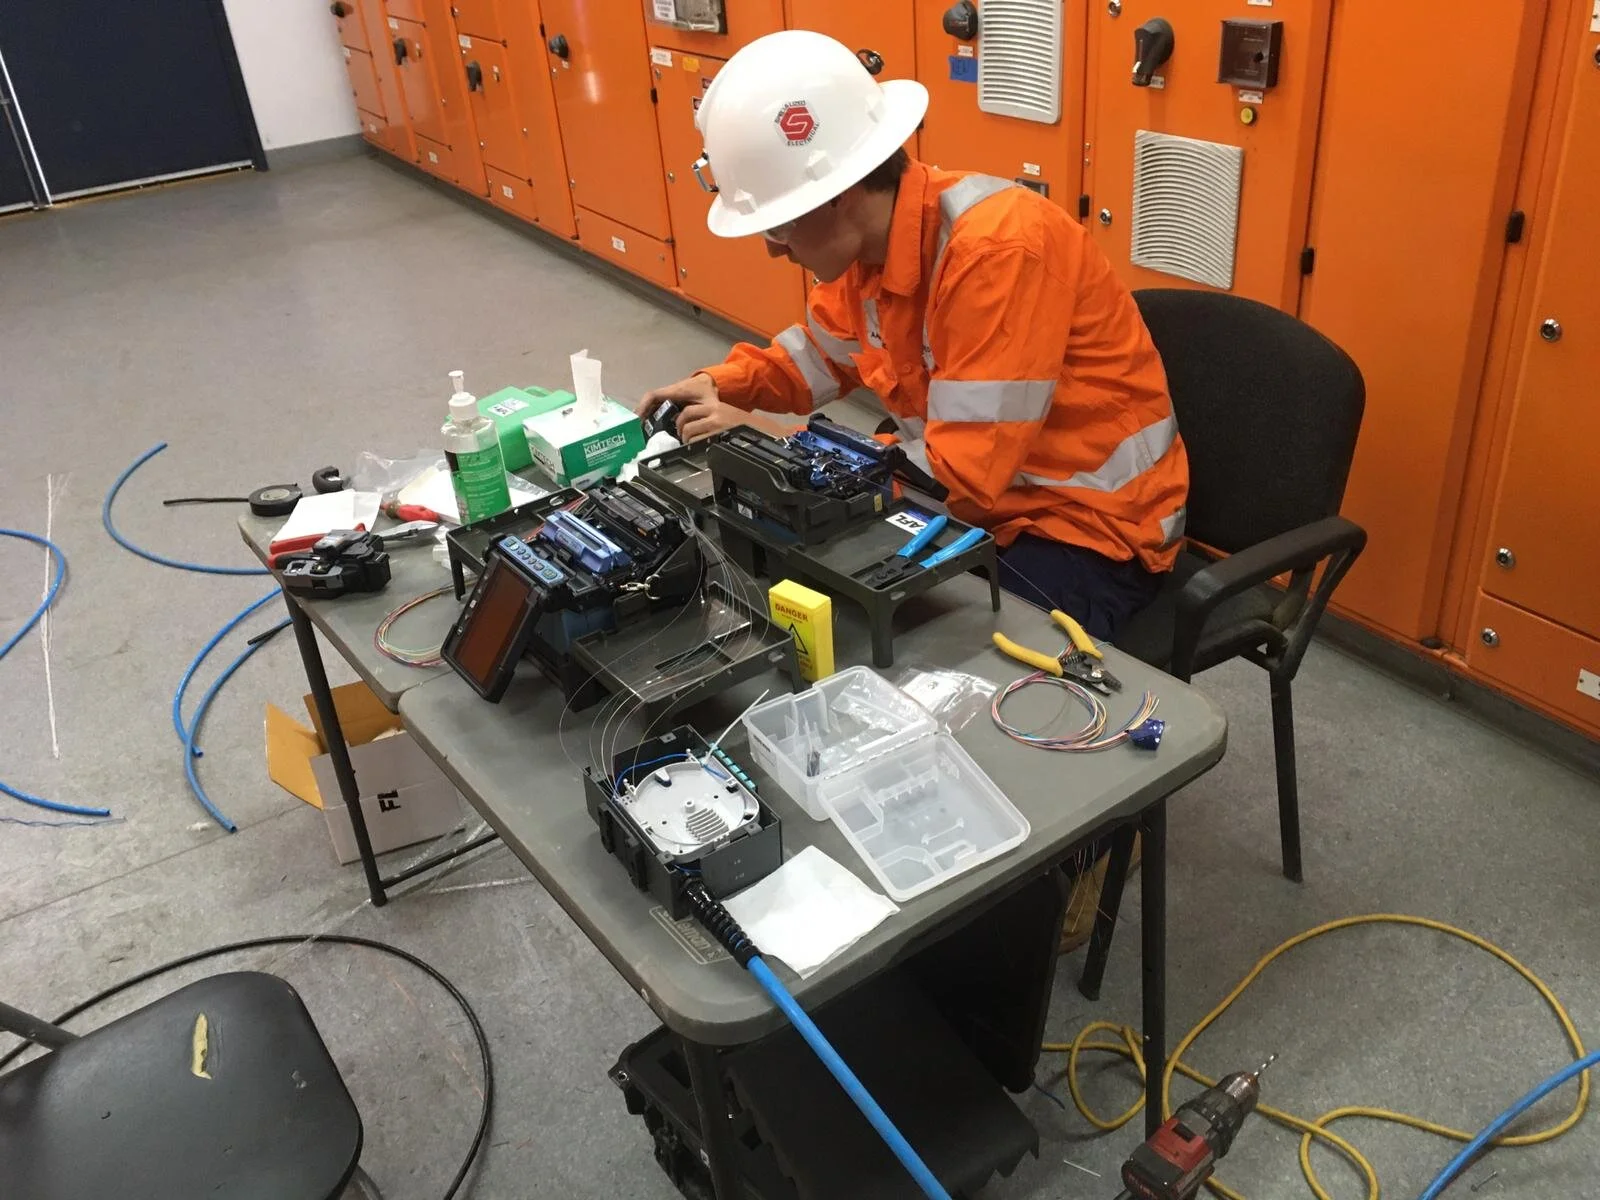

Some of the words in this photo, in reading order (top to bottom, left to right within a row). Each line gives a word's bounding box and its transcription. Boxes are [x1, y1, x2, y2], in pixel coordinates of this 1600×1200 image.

[787, 122, 820, 147] ELECTRICAL
[583, 432, 626, 457] KIMTECH
[895, 514, 924, 529] AFL
[775, 603, 809, 622] DANGER
